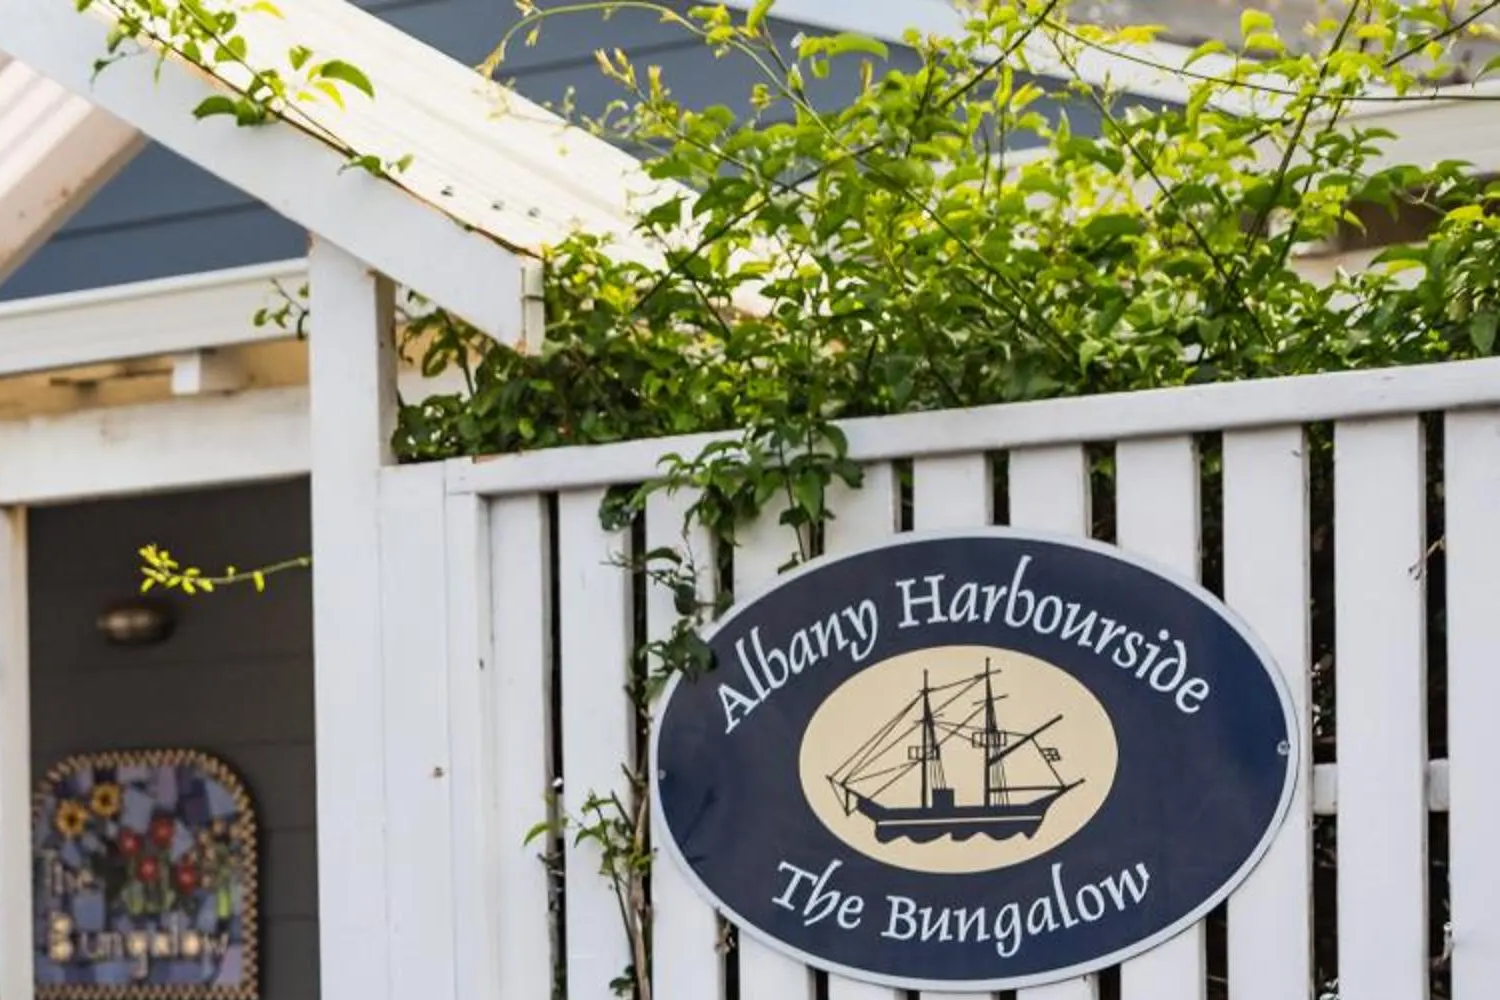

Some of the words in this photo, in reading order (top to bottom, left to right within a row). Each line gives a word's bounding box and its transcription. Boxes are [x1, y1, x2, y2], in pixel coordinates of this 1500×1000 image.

[716, 597, 879, 734] Albany
[895, 554, 1210, 715] Harbourside
[771, 858, 864, 930] The
[881, 862, 1151, 957] Bungalow
